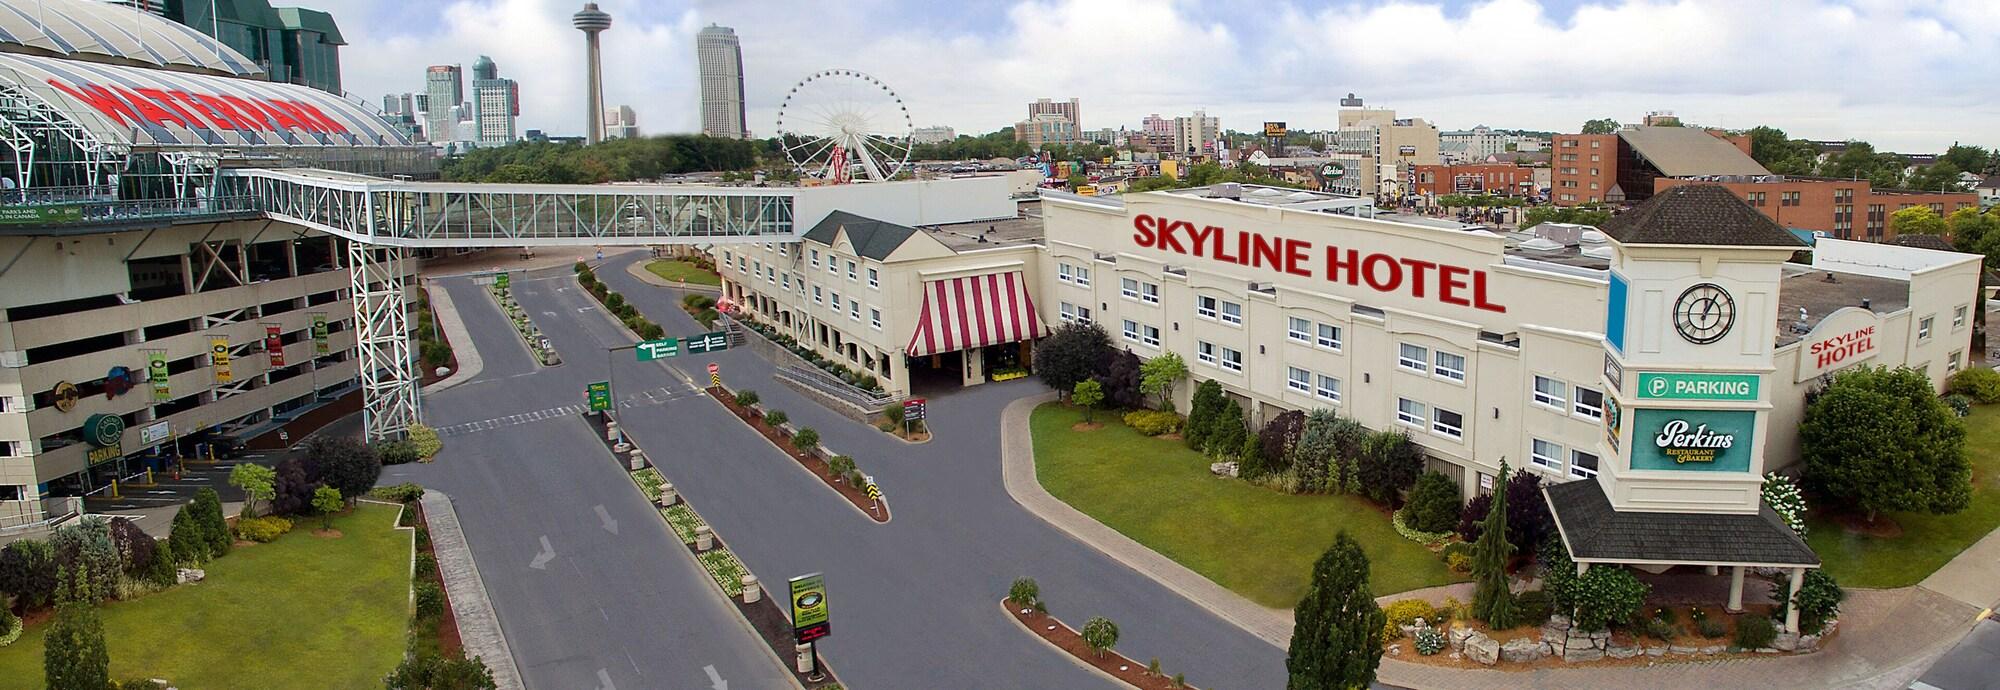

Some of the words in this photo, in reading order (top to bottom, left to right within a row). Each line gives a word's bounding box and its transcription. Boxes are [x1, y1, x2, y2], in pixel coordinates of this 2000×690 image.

[47, 79, 349, 134] WATERPARK
[1133, 214, 1312, 277] SKYLINE
[1326, 245, 1506, 313] HOTEL
[1811, 325, 1875, 355] SKYLINE
[1818, 337, 1875, 369] HOTEL
[1653, 380, 1665, 393] P
[1675, 381, 1749, 395] PARKING
[1655, 420, 1734, 448] Perkins
[89, 444, 121, 465] PARKING
